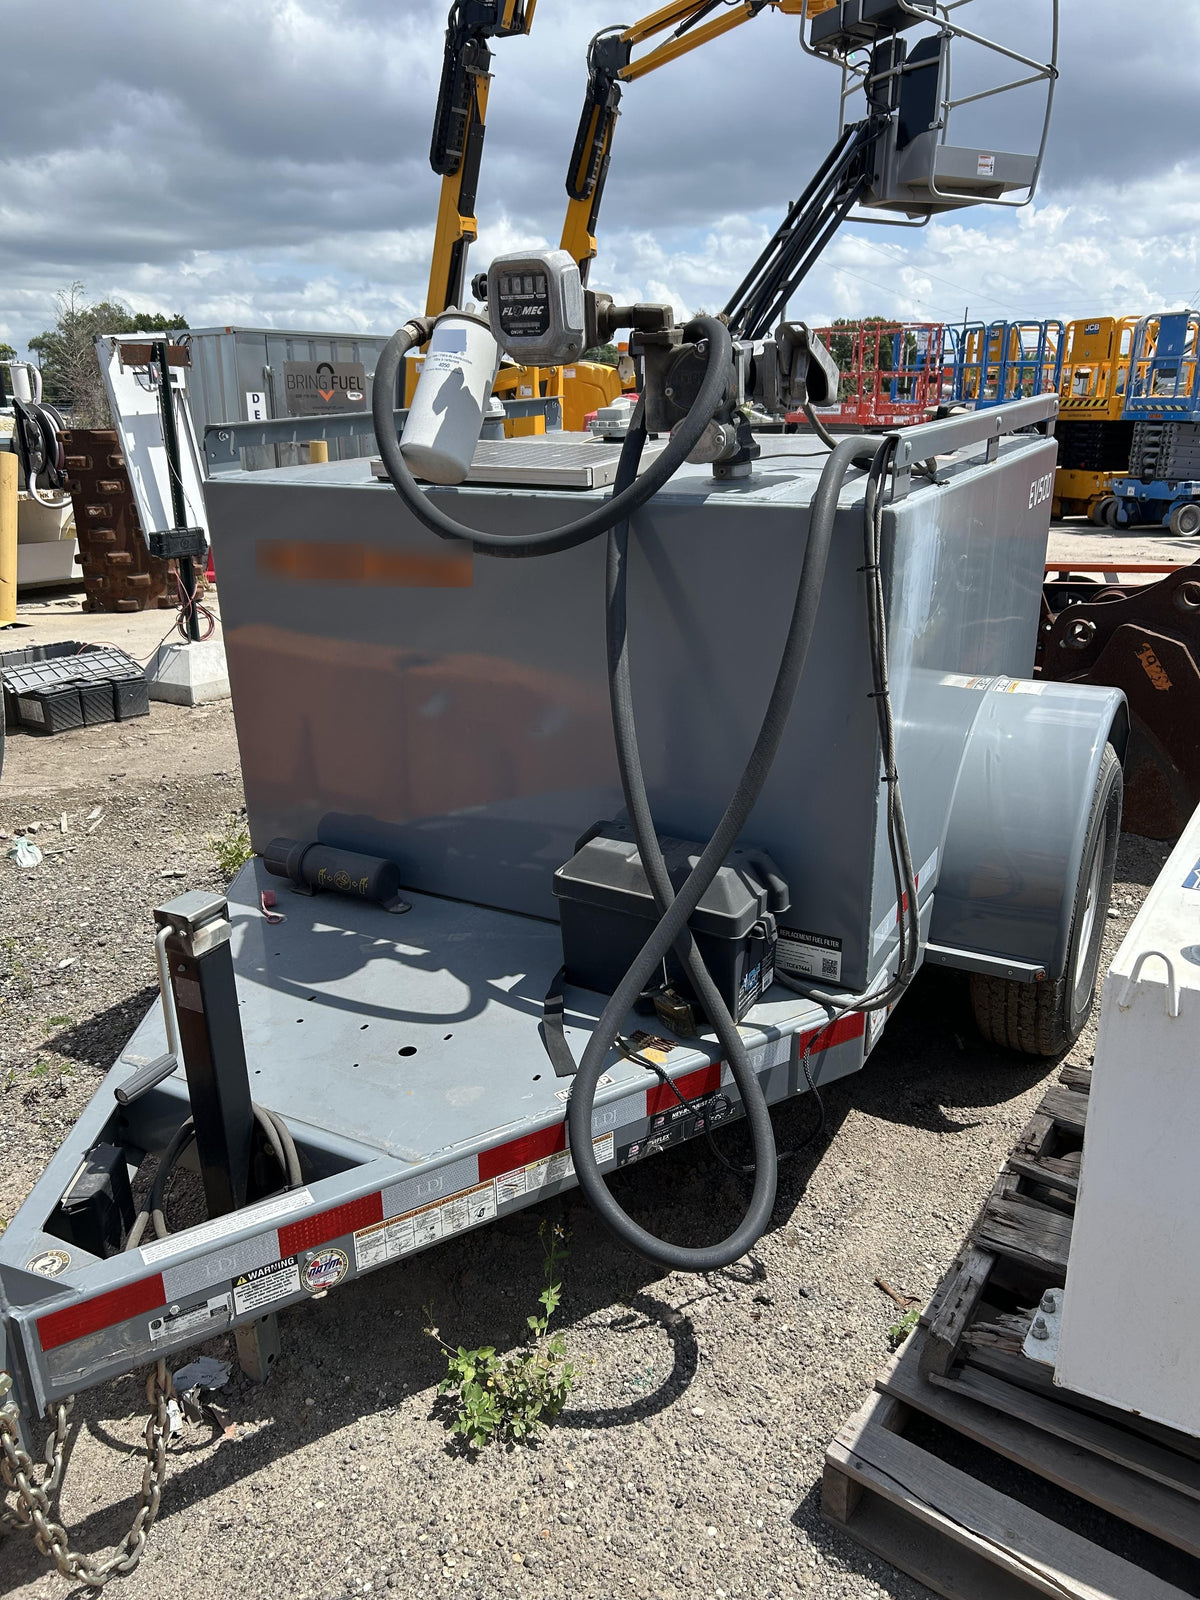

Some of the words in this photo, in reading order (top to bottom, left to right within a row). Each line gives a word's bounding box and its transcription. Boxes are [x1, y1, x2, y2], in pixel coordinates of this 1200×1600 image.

[1084, 323, 1100, 332] JCB
[286, 374, 328, 390] BRING
[331, 375, 364, 391] FUEL
[1028, 472, 1053, 510] EV500
[780, 928, 813, 942] REPLACEMENT
[812, 936, 823, 945] FUEL
[823, 938, 840, 948] FILTER
[247, 1257, 295, 1281] WARNING
